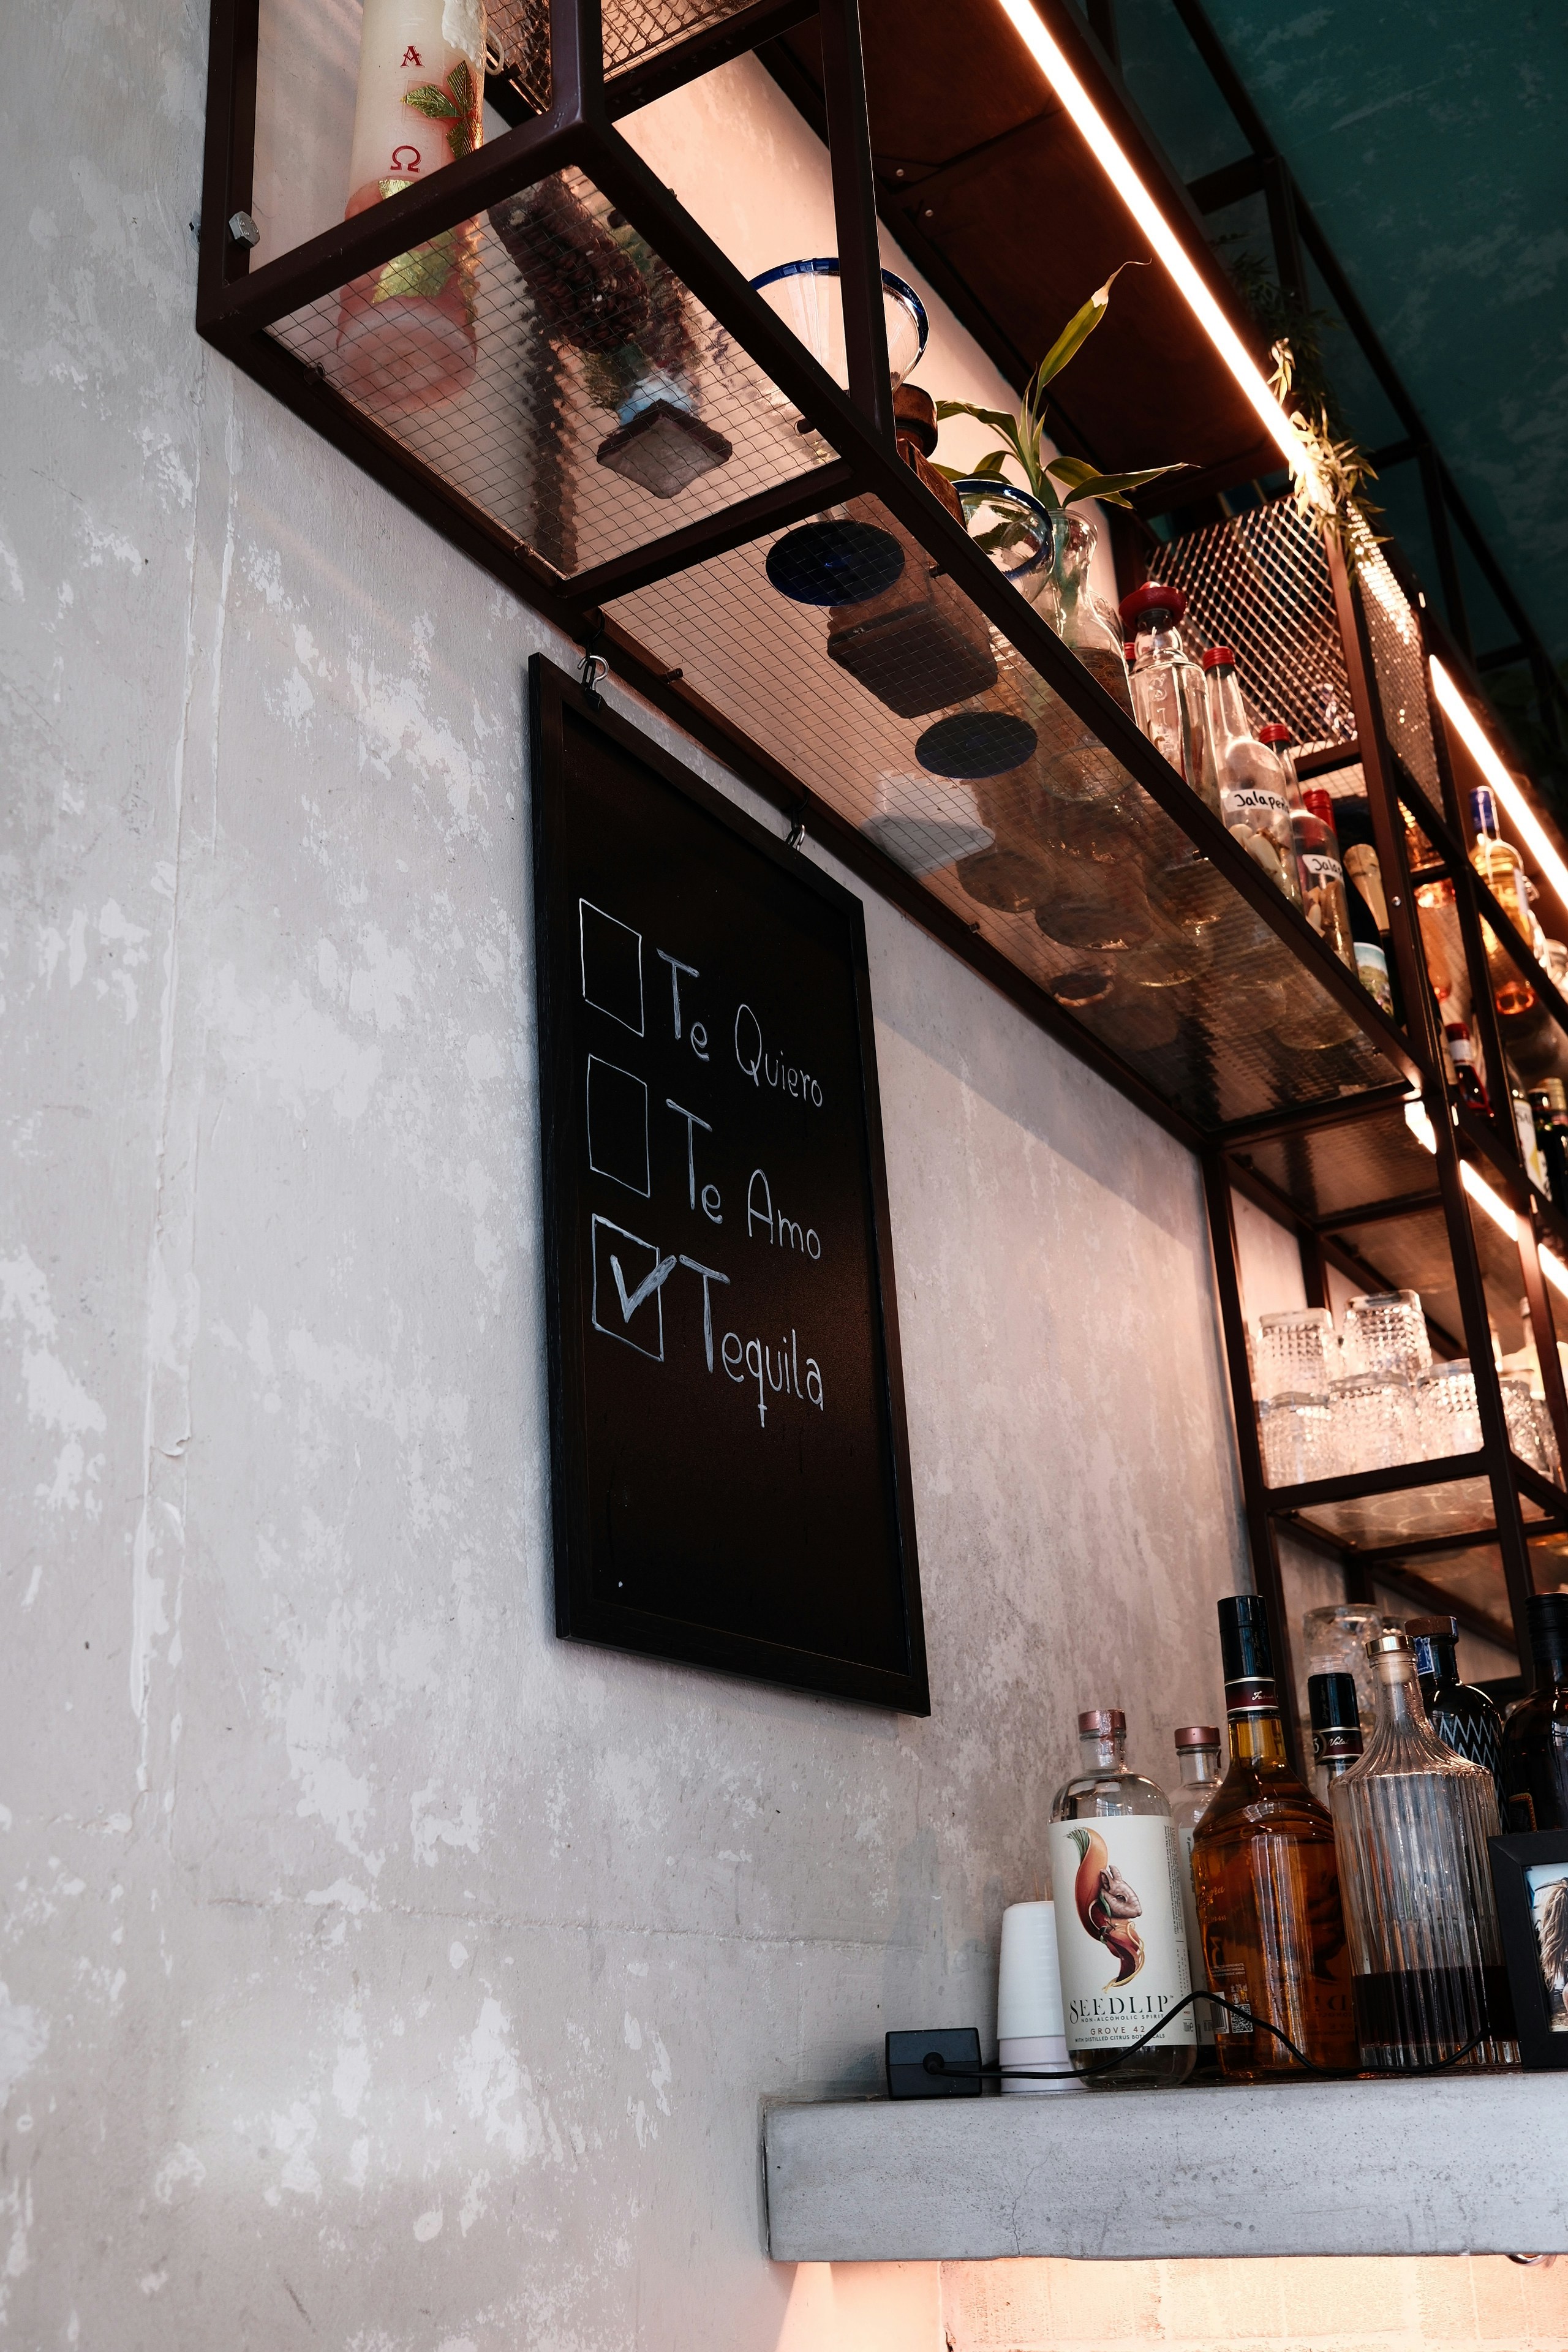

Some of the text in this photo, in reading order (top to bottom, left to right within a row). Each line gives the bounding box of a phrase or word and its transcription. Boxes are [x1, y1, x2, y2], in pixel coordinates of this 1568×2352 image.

[656, 948, 823, 1107] Te Quiero
[666, 1098, 821, 1260] Te Amo
[679, 1254, 824, 1428] Tequila
[1069, 1996, 1168, 2024] SEEDLIP
